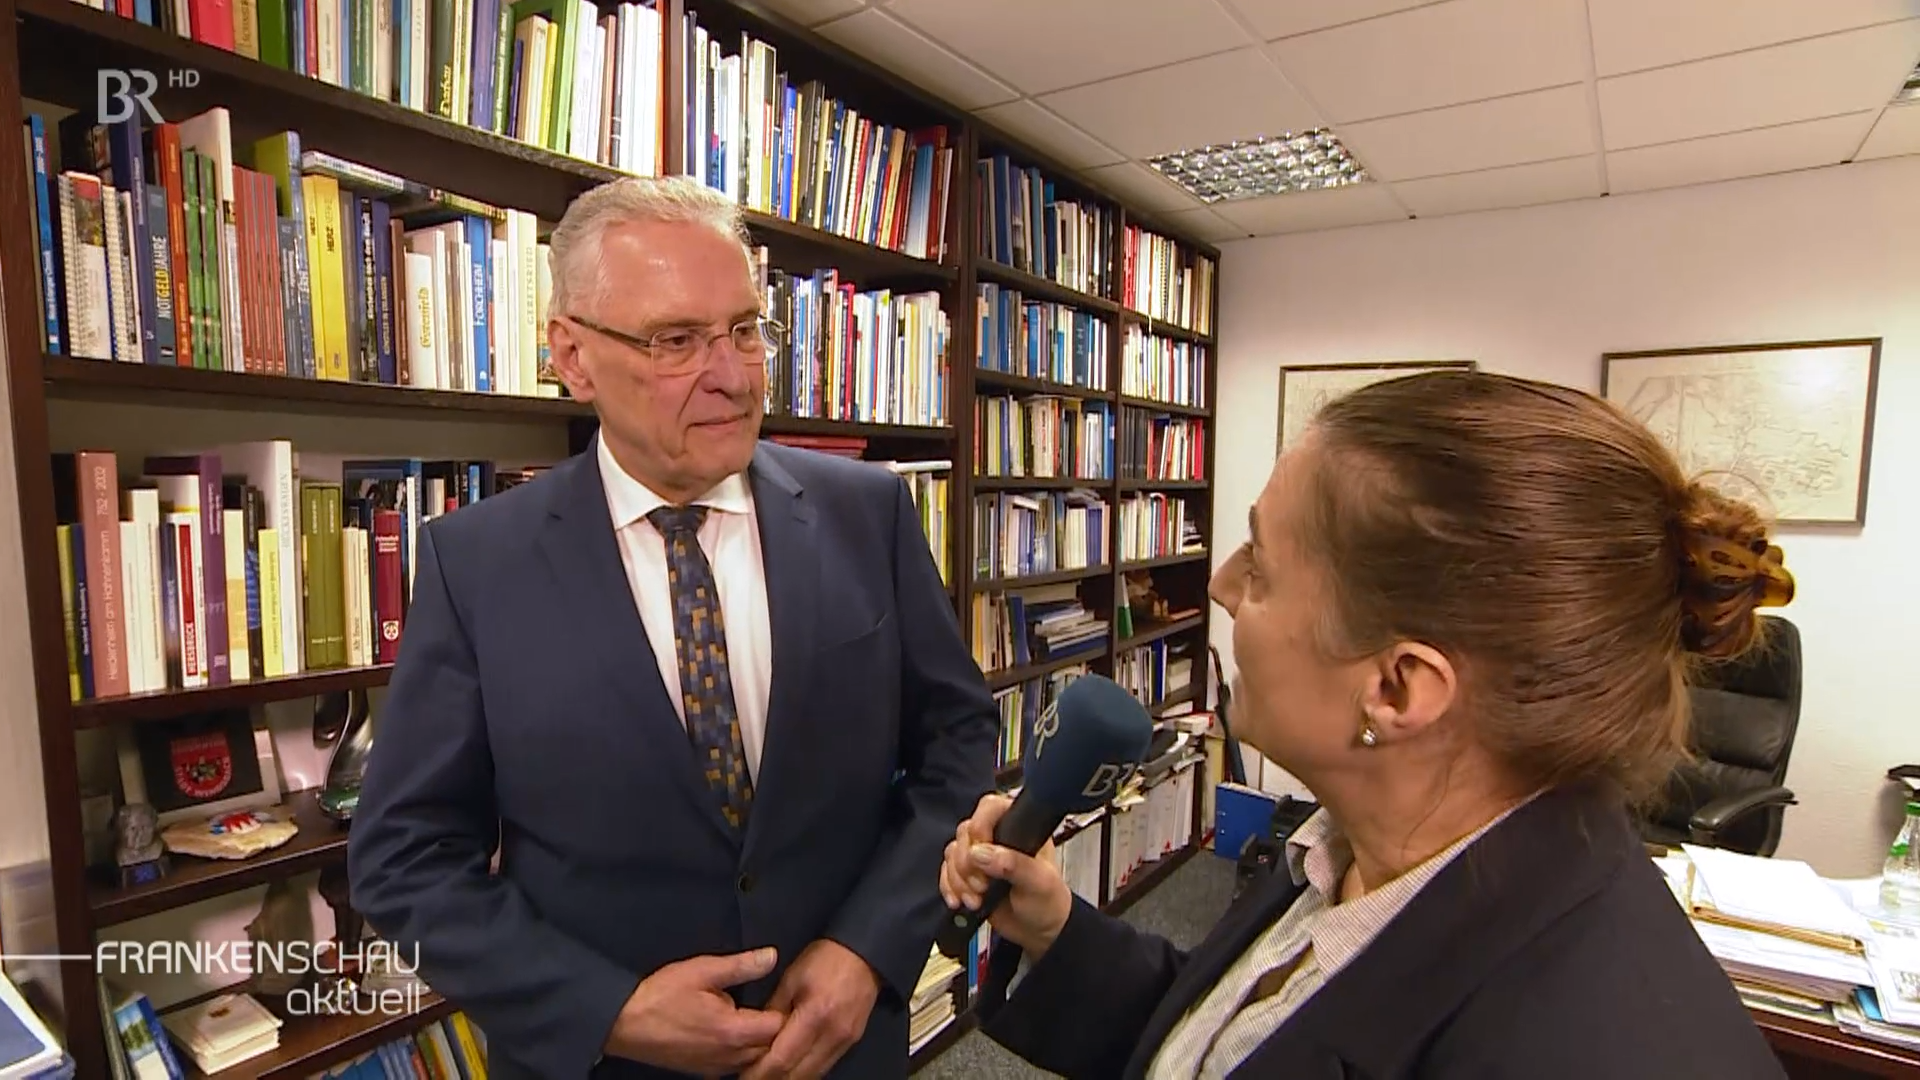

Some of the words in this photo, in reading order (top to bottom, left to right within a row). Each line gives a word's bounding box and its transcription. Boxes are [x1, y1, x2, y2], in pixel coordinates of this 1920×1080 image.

[326, 226, 335, 252] HERZ
[152, 235, 171, 319] NOTGELDJAHRE
[473, 263, 485, 326] FORCHHEIM
[526, 246, 534, 325] GERETSRIED
[94, 466, 107, 490] 2002
[96, 498, 109, 516] 752
[100, 530, 114, 600] Hahnenkamm
[105, 602, 115, 620] am
[105, 621, 119, 680] Heidenheim
